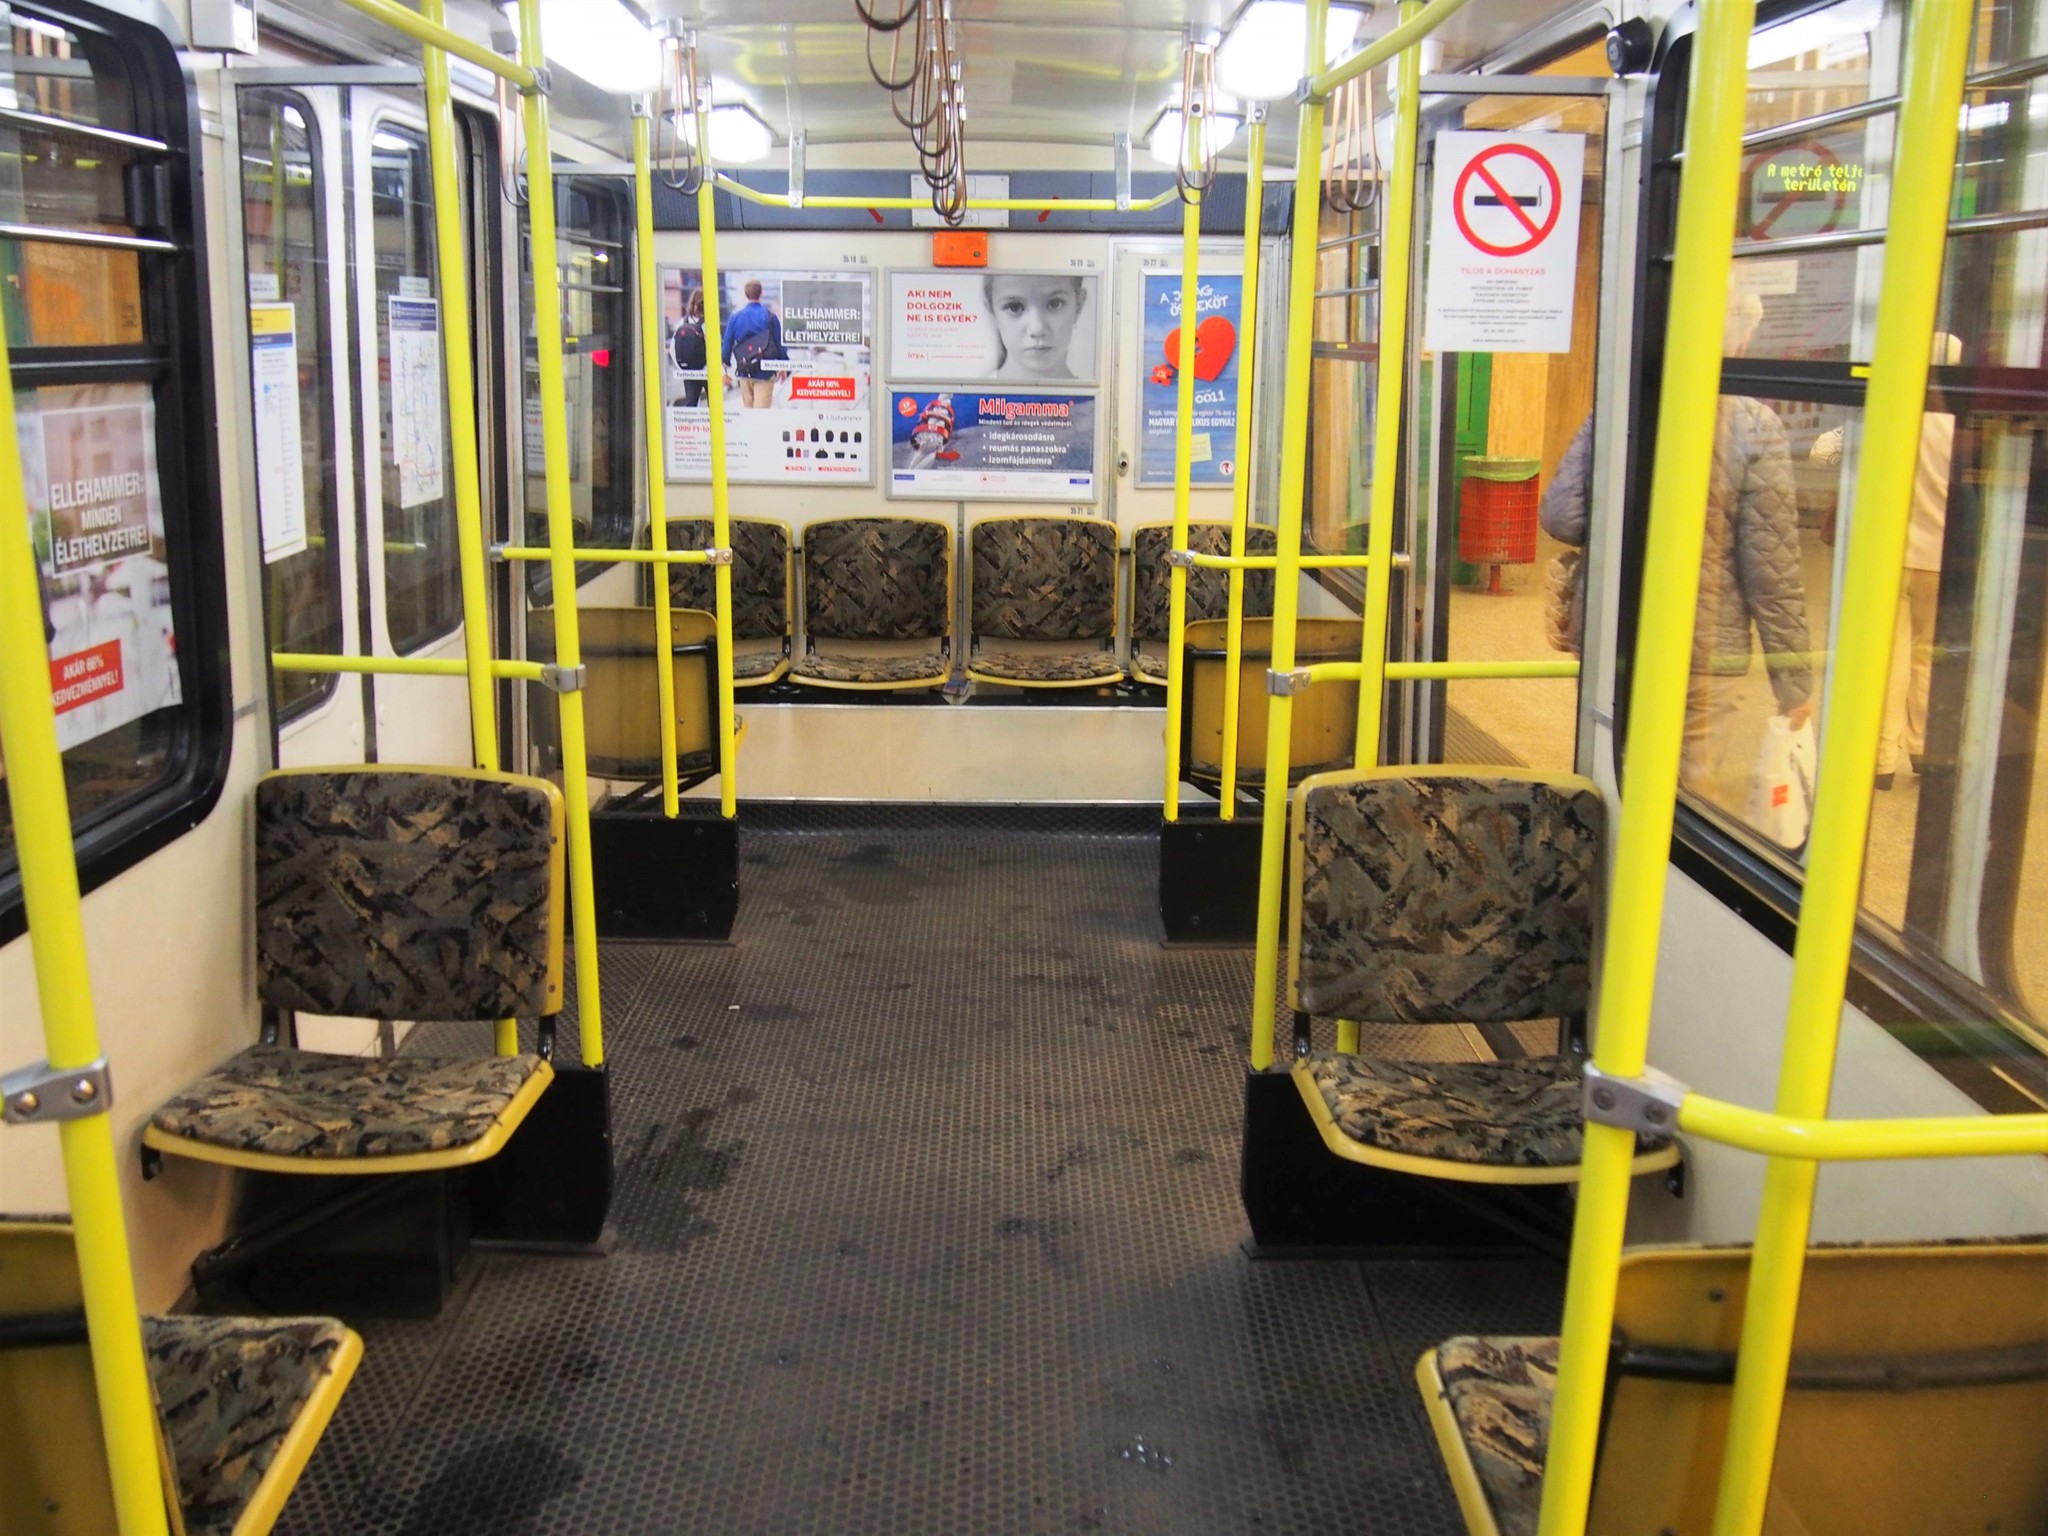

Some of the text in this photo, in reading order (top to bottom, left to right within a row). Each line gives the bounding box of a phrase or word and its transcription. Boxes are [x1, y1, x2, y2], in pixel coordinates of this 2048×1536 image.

[1767, 163, 1776, 177] A
[1781, 163, 1822, 177] metró
[907, 290, 952, 298] AKI NEM
[906, 302, 963, 311] DOLGOZIK
[784, 307, 861, 321] ELLEHAMMER:
[906, 313, 978, 323] NE IS EGYÉK?
[806, 320, 840, 332] MINDEN
[784, 329, 861, 343] ÉLETHELYZETRE!
[807, 379, 825, 388] AKÁR
[796, 387, 851, 398] KEDVEZMÉNNYEL!
[1211, 416, 1236, 427] EGYHÁZ
[989, 431, 1055, 443] idegkárosodásra
[989, 444, 1018, 453] reumás
[51, 471, 146, 511] ELLEHAMMER:
[81, 504, 122, 532] MINDEN
[55, 524, 149, 565] ÉLETHELYZETRE!
